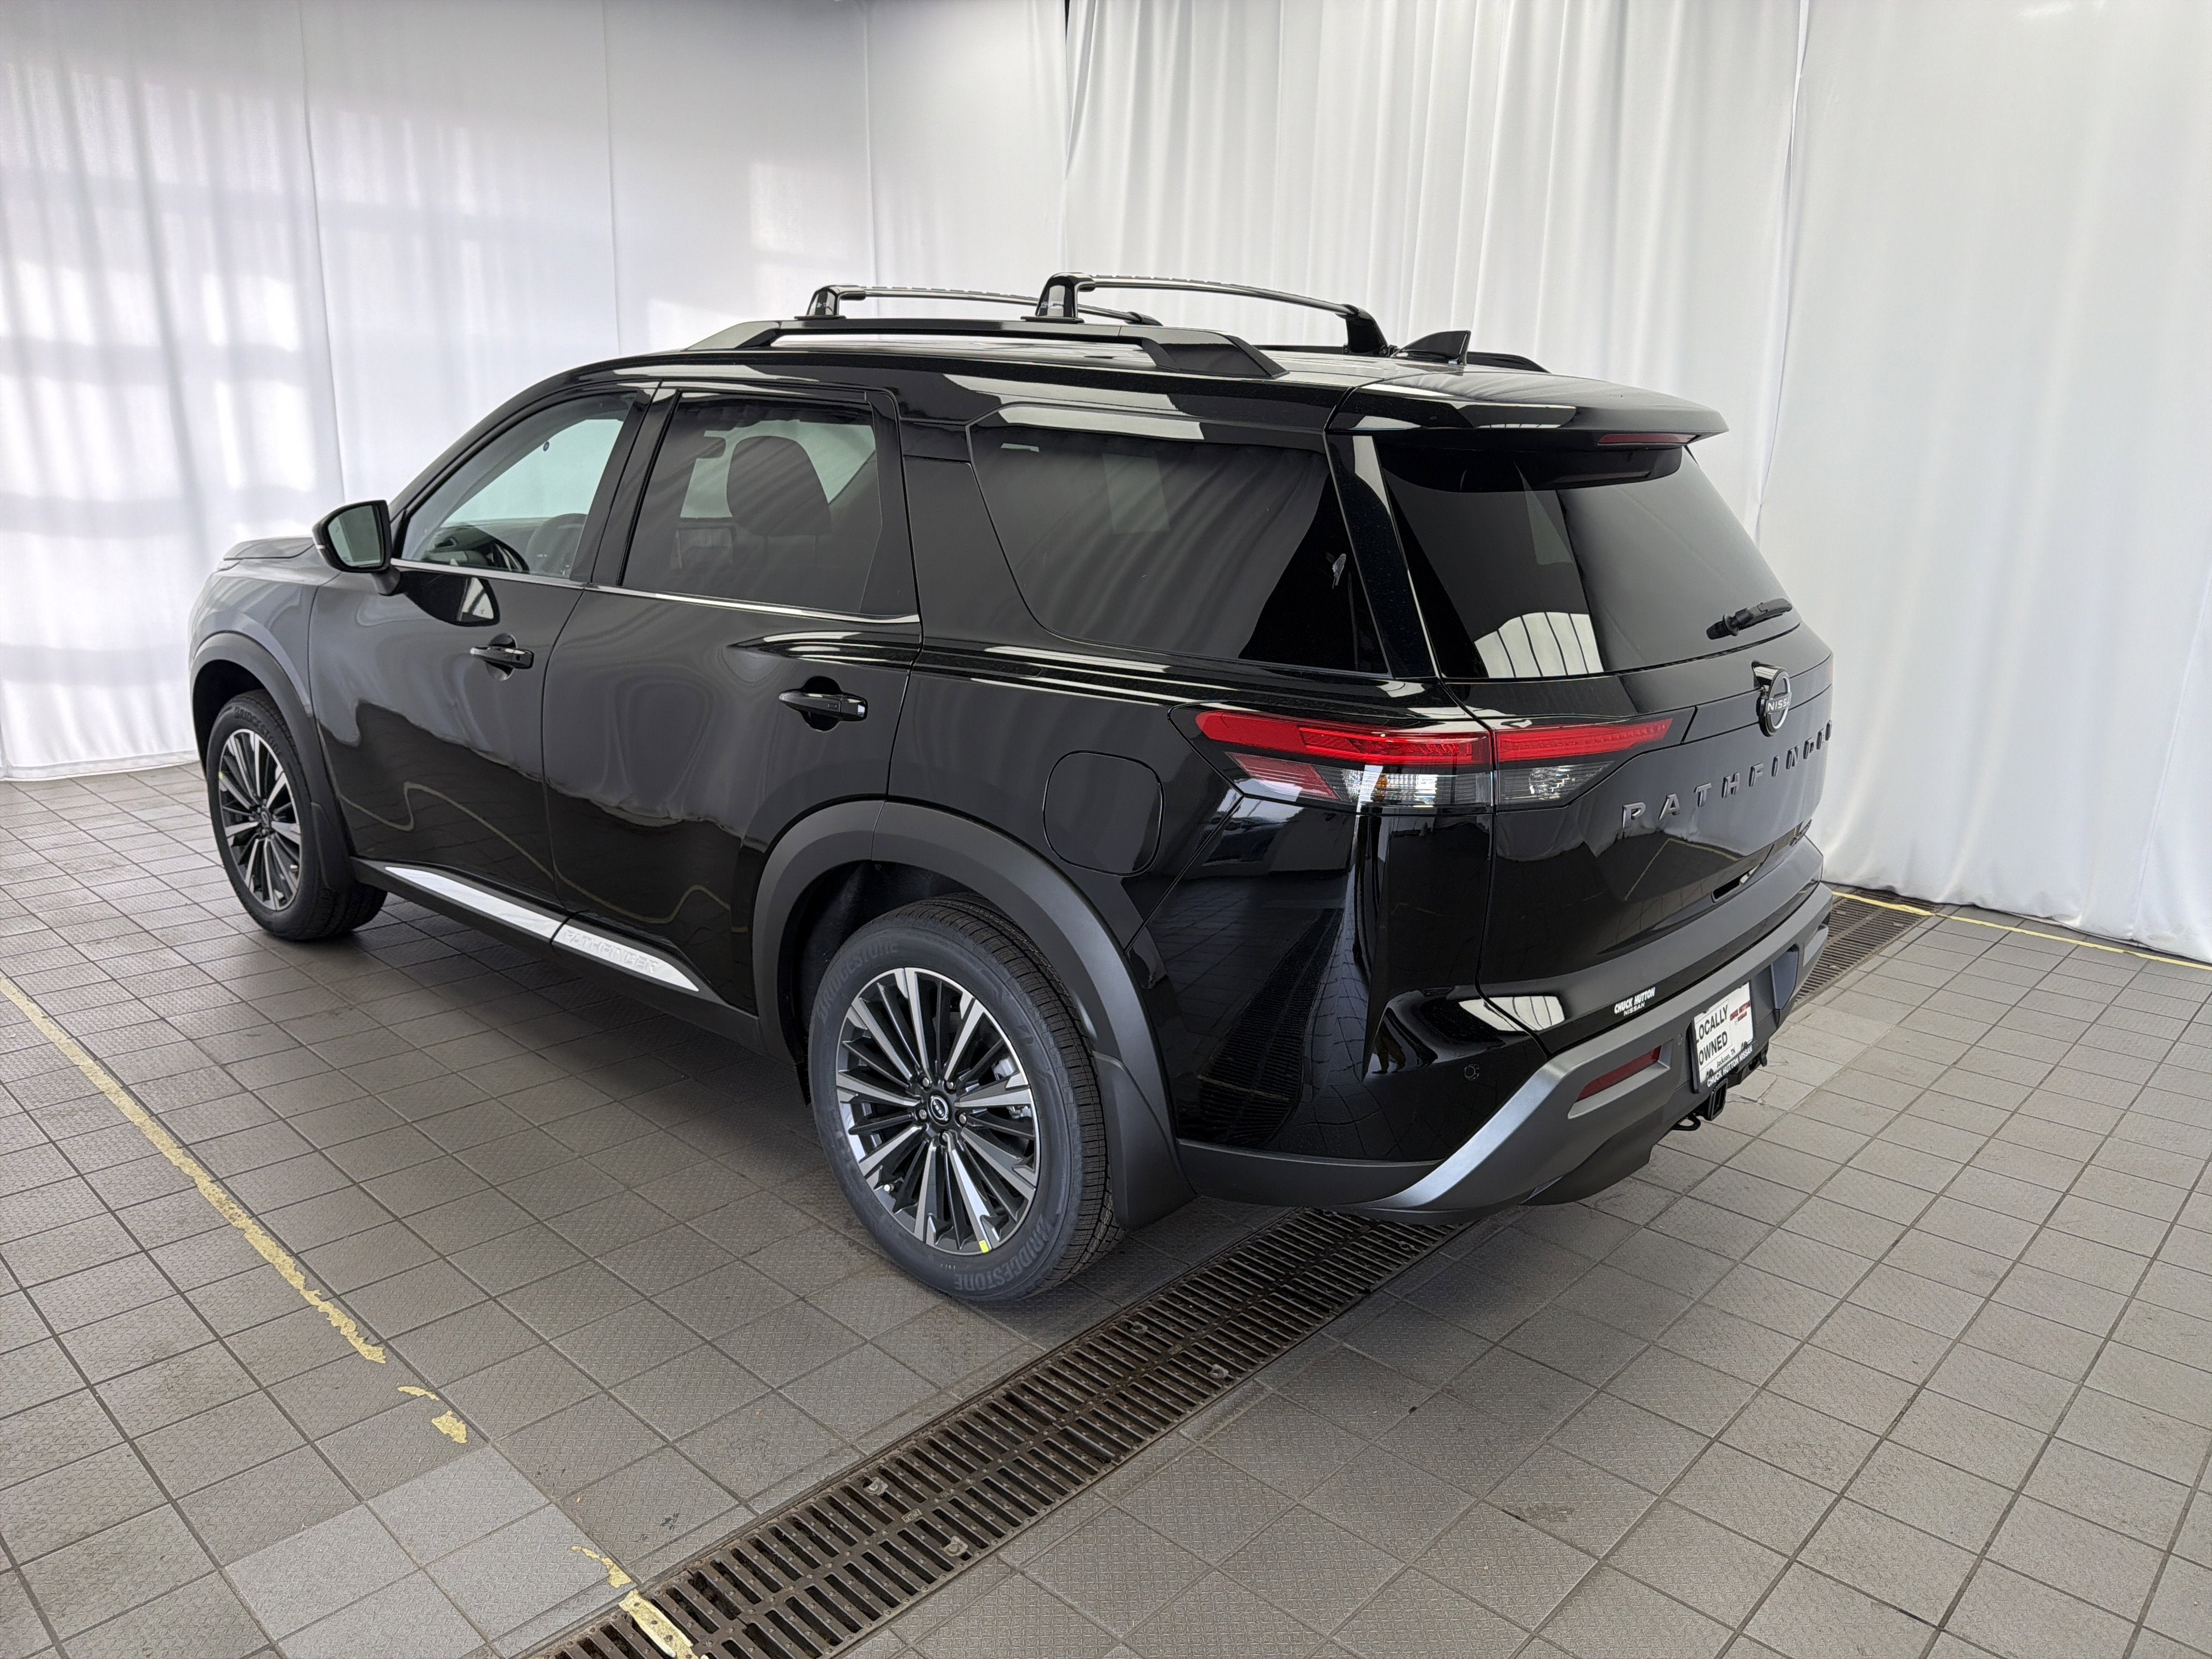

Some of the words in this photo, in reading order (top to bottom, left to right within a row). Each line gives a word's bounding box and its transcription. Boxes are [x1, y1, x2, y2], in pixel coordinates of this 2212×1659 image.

[1614, 997, 1633, 1014] CHUCK
[1634, 986, 1656, 1006] HUTTON
[1623, 1001, 1645, 1017] NISSAN
[1696, 1004, 1728, 1042] OCALLY
[1699, 1031, 1728, 1065] OWNED
[1707, 1070, 1723, 1087] CHUCK
[1723, 1056, 1739, 1076] HUTTON
[953, 1213, 1052, 1292] BRIDGESTONE
